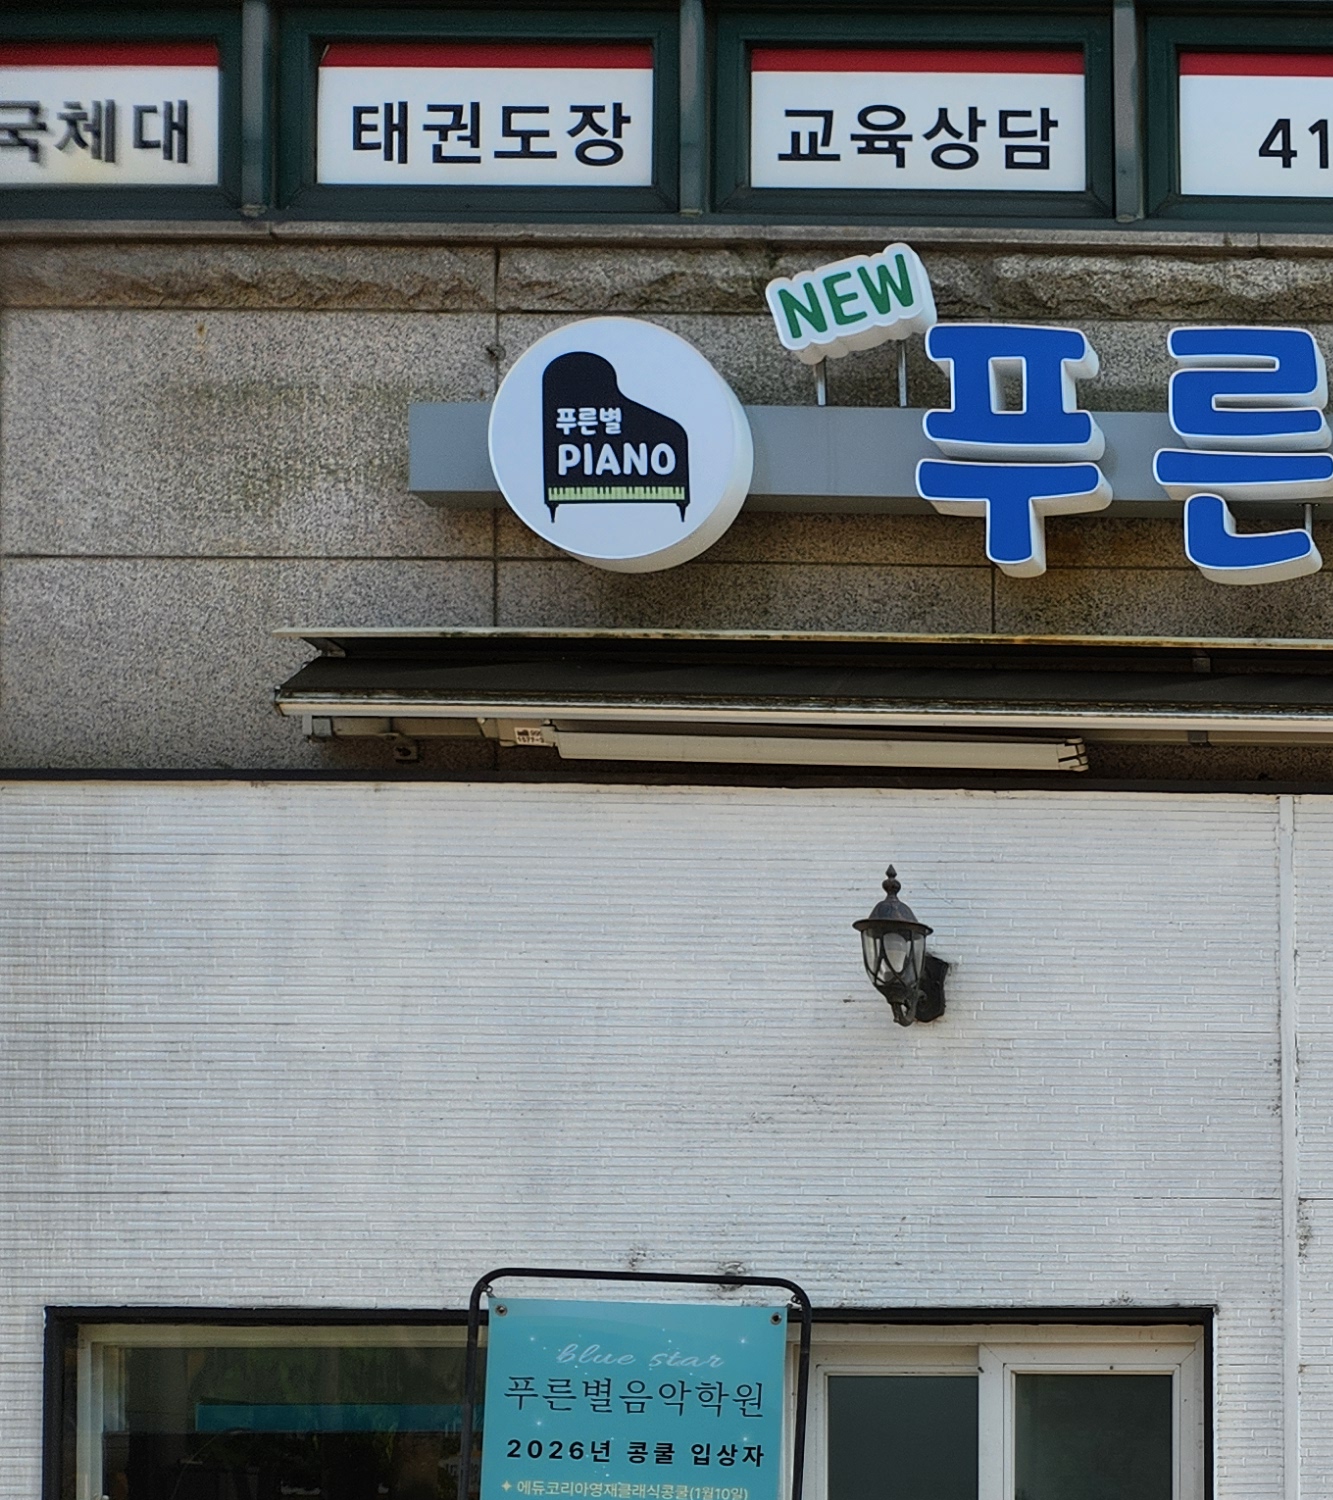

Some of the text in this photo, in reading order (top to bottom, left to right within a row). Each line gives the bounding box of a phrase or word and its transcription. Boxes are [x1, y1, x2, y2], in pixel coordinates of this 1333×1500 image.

[353, 101, 631, 166] 태권도장
[778, 105, 1058, 170] 교육상담
[777, 253, 914, 339] NEW
[556, 408, 621, 435] 푸른별
[559, 443, 675, 475] PIANO
[556, 1344, 724, 1368] blue star
[504, 1376, 764, 1418] 푸른별음악학원
[507, 1440, 764, 1467] 2026년 콩쿨 입상자
